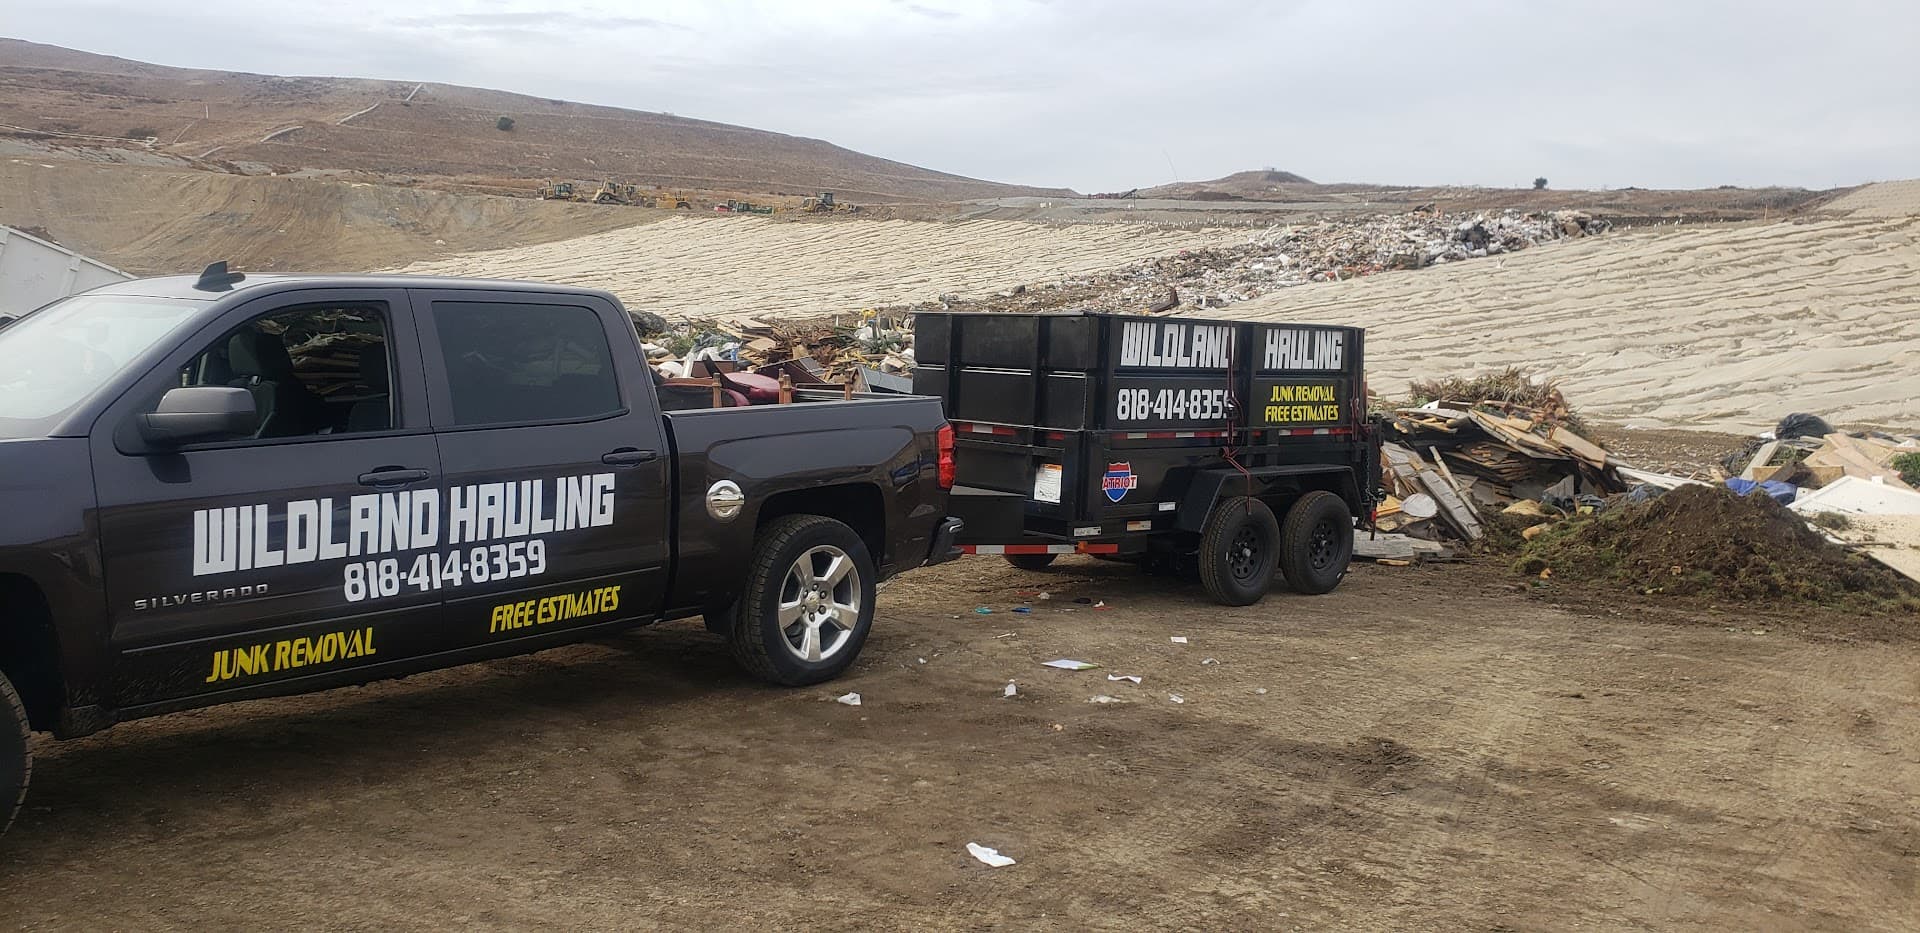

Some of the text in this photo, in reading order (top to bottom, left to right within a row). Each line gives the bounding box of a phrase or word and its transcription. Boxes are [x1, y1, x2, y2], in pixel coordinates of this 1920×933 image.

[1120, 321, 1343, 370] WILDLAND HAULING
[1264, 404, 1339, 422] FREE ESTIMATES
[1270, 385, 1336, 402] JUNK REMOVAL
[193, 472, 616, 577] WILDLAND HAULING
[343, 539, 546, 602] 818-414-8359
[133, 583, 269, 611] SILVERADO
[490, 585, 621, 633] FREE ESTIMATES
[205, 626, 377, 684] JUNK REMOVAL
